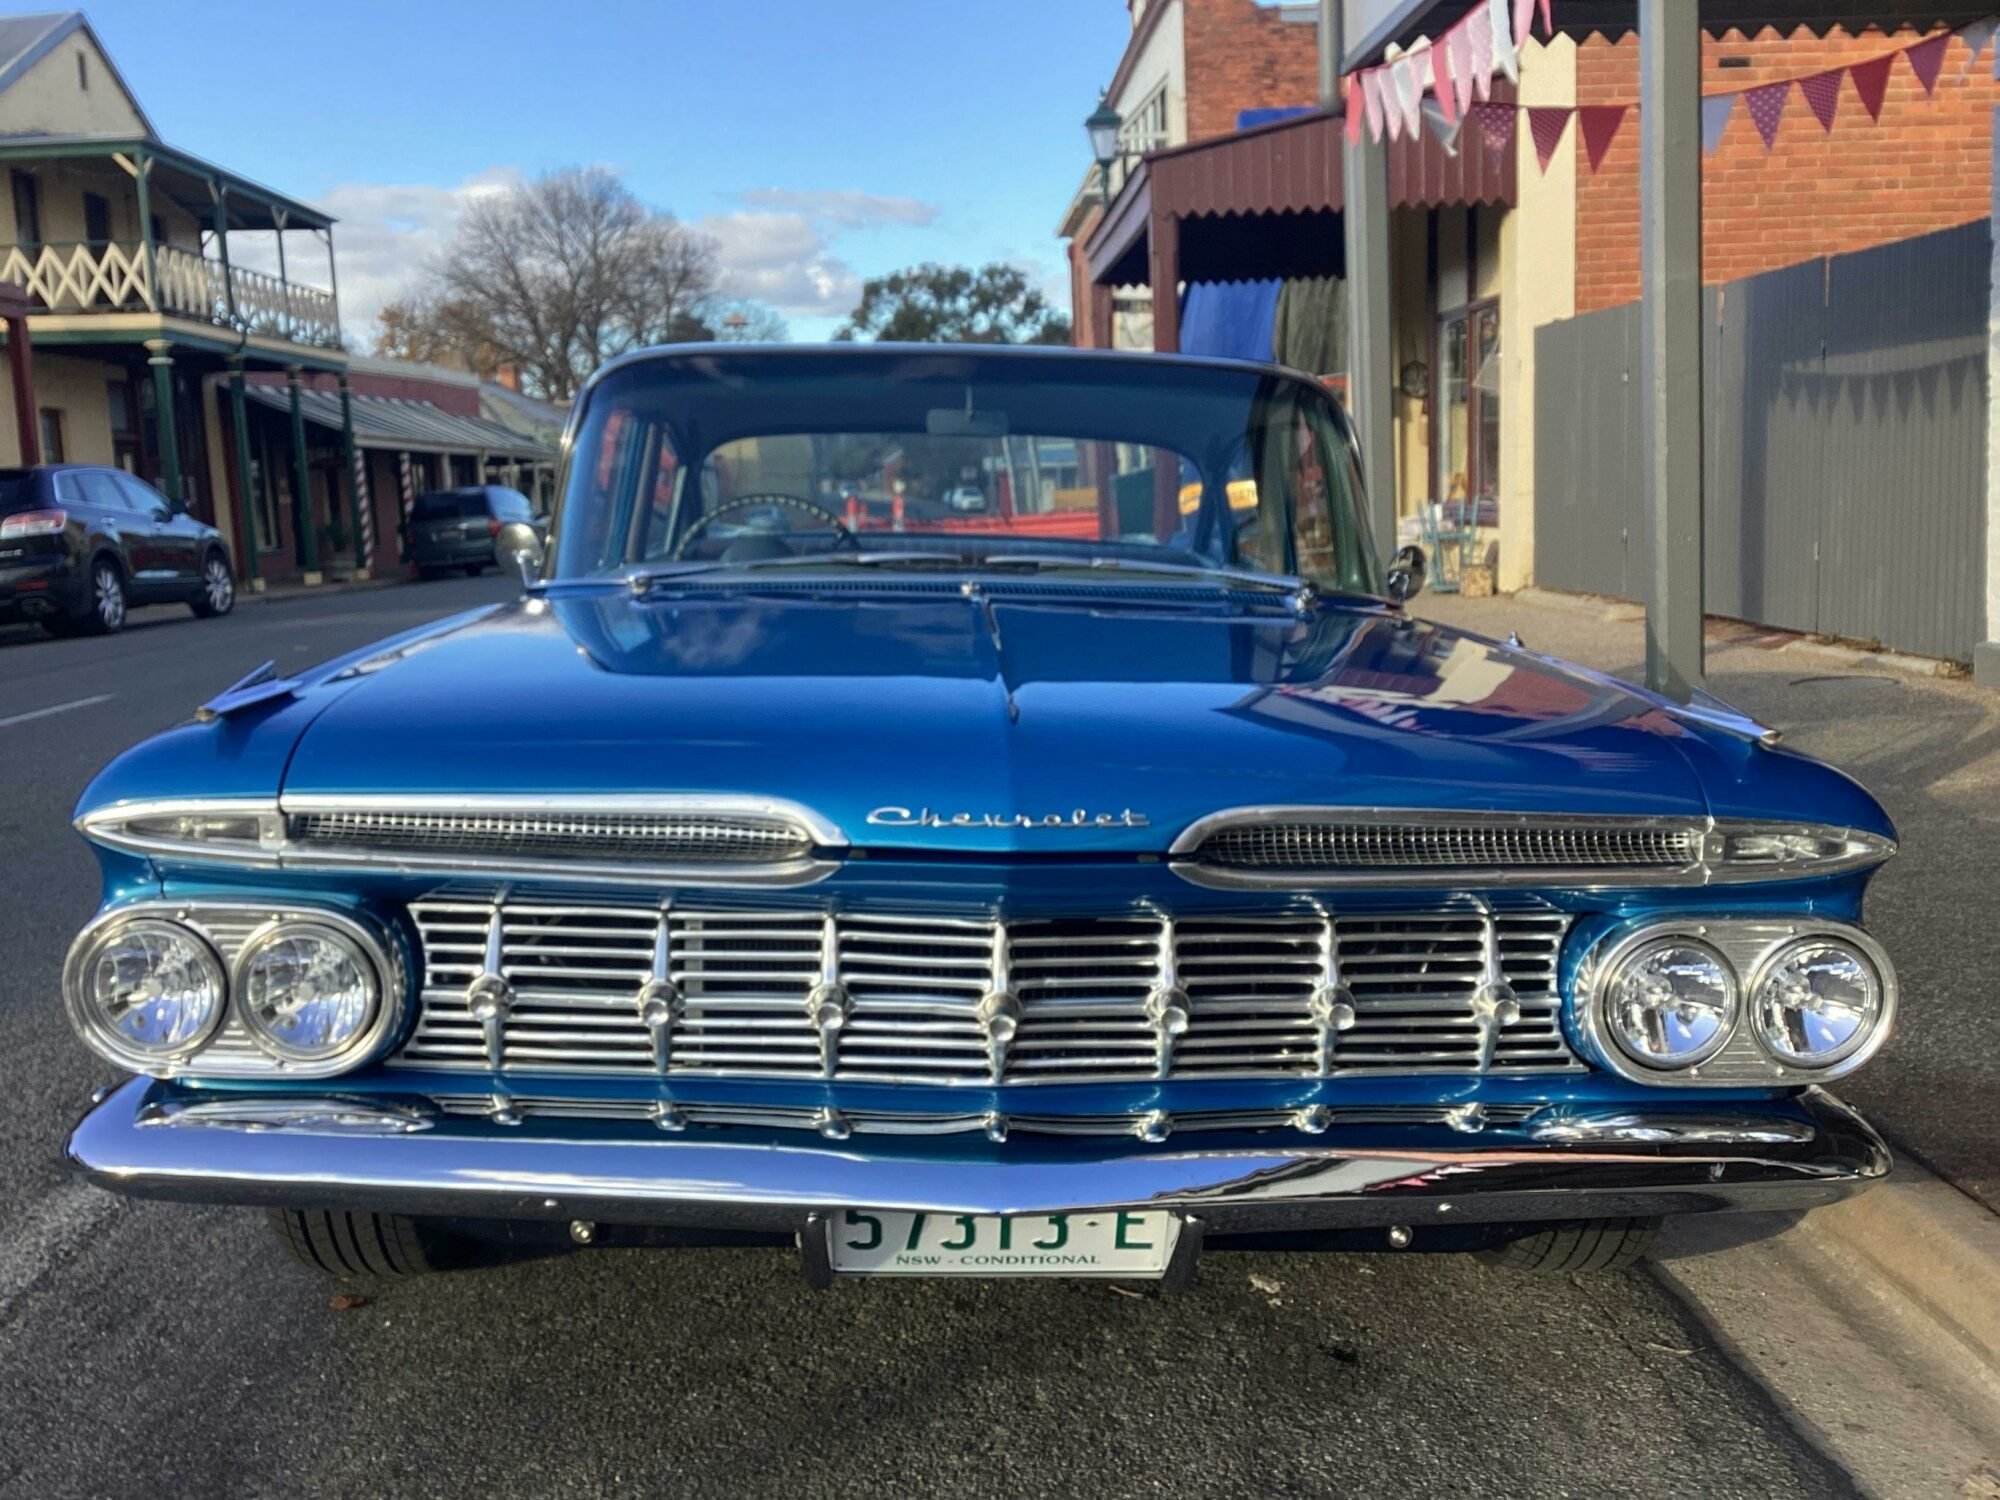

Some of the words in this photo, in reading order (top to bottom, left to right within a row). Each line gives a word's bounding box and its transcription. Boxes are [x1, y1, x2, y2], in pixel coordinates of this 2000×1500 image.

[866, 806, 1150, 827] Chevrolet
[896, 1254, 941, 1266] NSW
[960, 1254, 1101, 1266] CONDITIONAL
